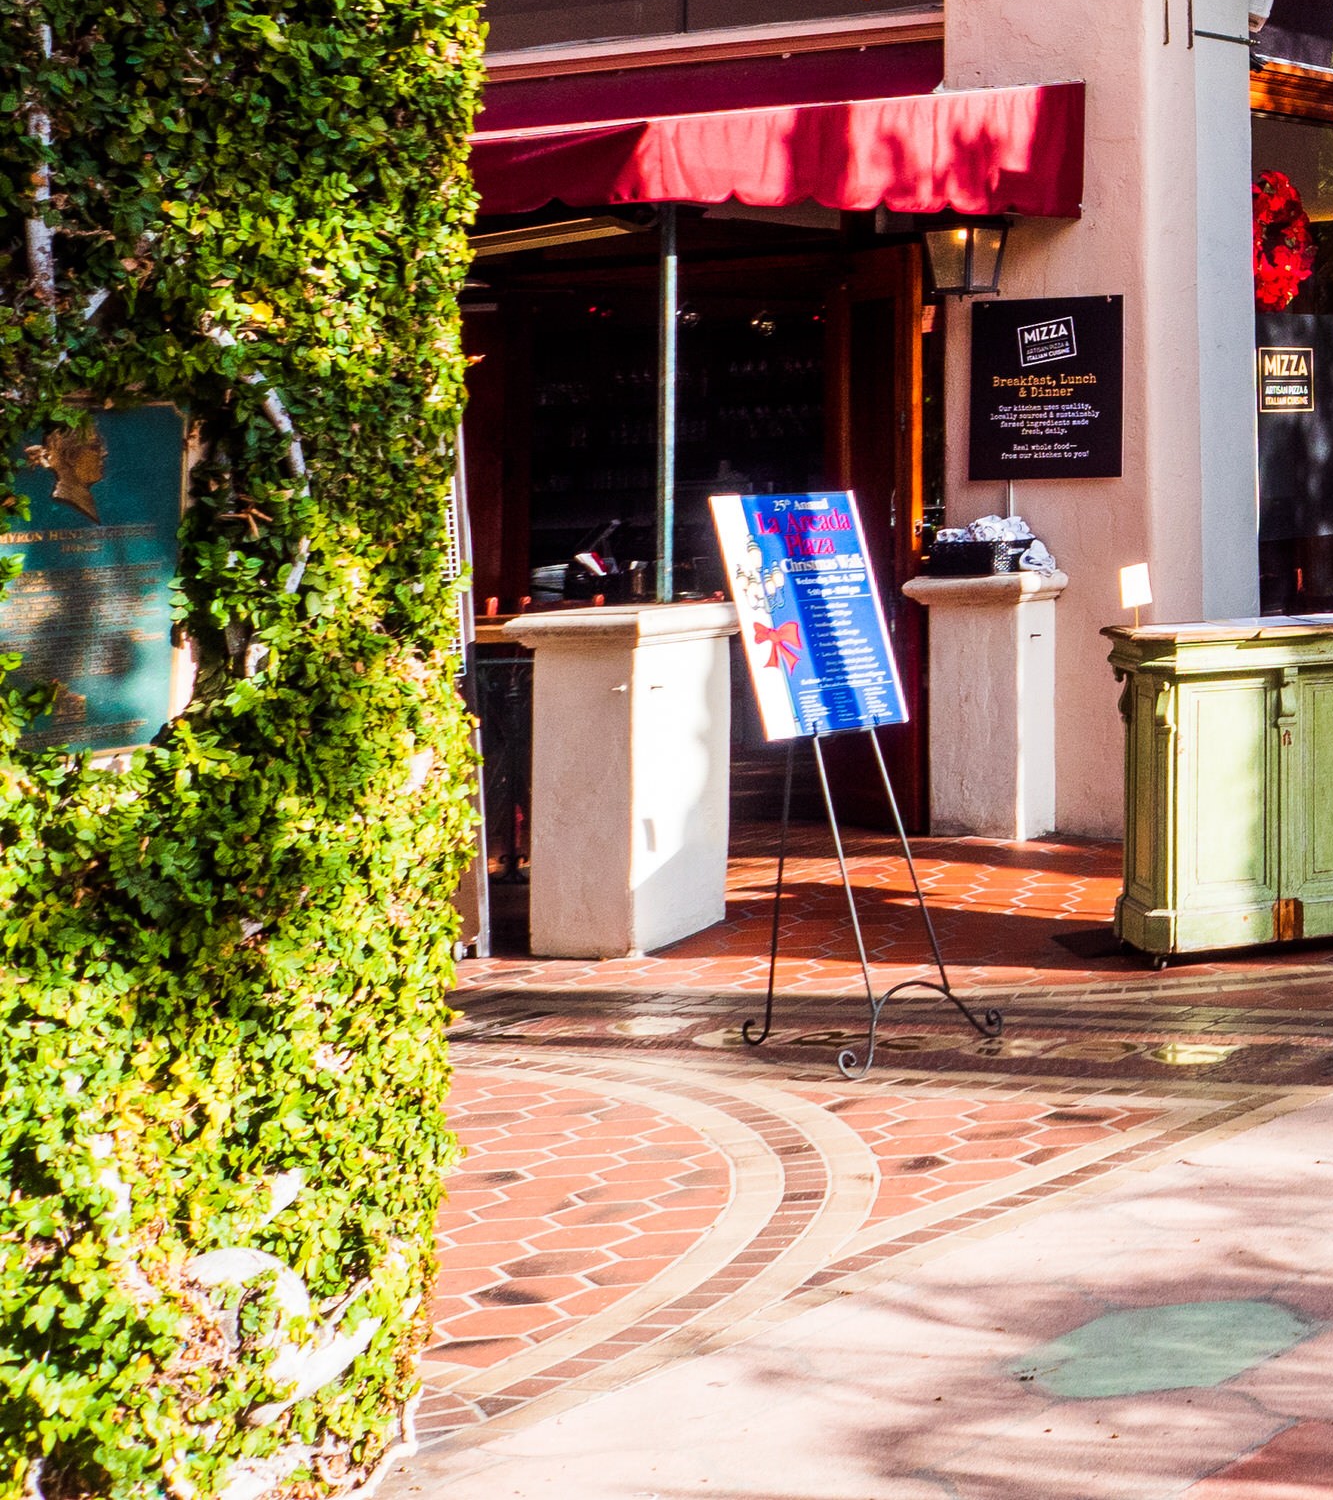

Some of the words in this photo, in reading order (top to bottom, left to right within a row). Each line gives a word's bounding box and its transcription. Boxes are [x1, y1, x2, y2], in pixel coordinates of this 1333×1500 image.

[1024, 323, 1069, 344] MIZZA
[1026, 352, 1048, 361] ITALIAN
[1048, 347, 1070, 357] CUISINE
[1264, 354, 1308, 376] MIZZA
[992, 375, 1056, 388] Breakfast,
[1060, 373, 1097, 384] Lunch
[1018, 387, 1027, 397] &
[1031, 386, 1074, 397] Dinner
[1265, 385, 1288, 395] ARTISAN
[1288, 385, 1303, 395] PIZZA
[1013, 404, 1042, 412] kitchen
[1061, 402, 1092, 411] quality,
[990, 413, 1018, 421] locally
[1019, 411, 1047, 419] sourced
[1055, 409, 1100, 419] sustainably
[1026, 419, 1070, 428] ingredients
[1021, 428, 1044, 436] fresh,
[1001, 452, 1018, 460] from
[1033, 451, 1062, 459] kitchen
[754, 511, 781, 534] La
[786, 507, 852, 533] Arcada
[784, 533, 836, 557] Plaza
